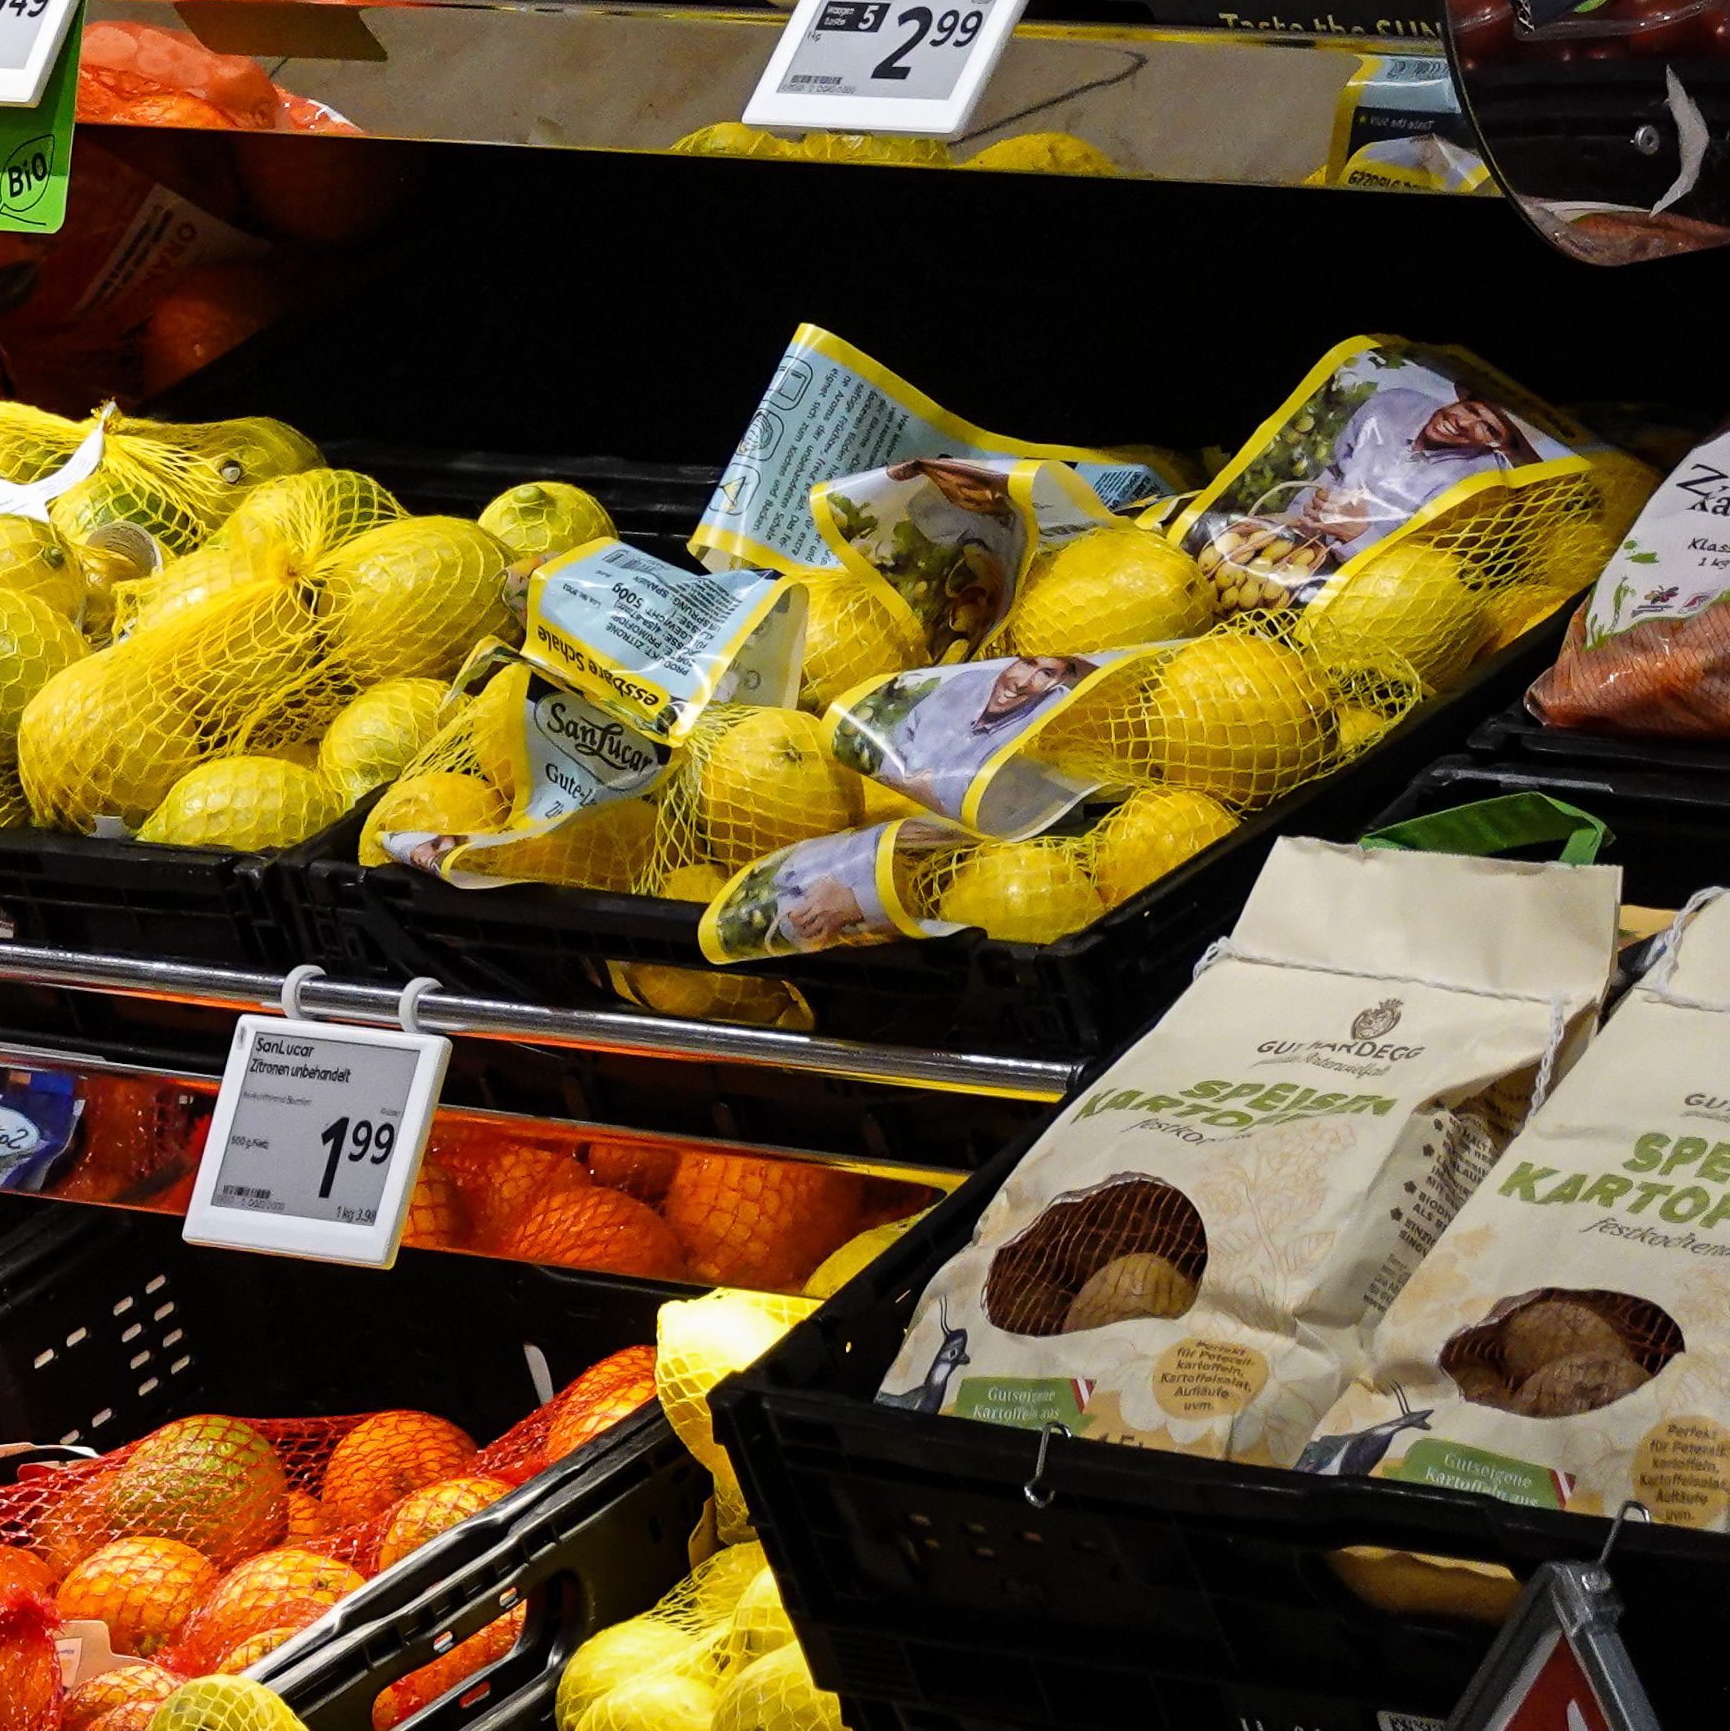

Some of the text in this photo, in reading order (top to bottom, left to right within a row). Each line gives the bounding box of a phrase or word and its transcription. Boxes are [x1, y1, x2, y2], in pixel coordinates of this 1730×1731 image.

[857, 4, 876, 31] 5
[7, 152, 49, 200] BiO
[611, 582, 645, 609] 500g
[605, 622, 645, 649] ZITRONE
[536, 624, 659, 708] essbare Schale
[544, 701, 653, 774] SanLucar
[255, 1037, 316, 1058] SanLucar
[249, 1058, 352, 1085] Zitronen unbehandelt
[1183, 1401, 1214, 1413] uvm.
